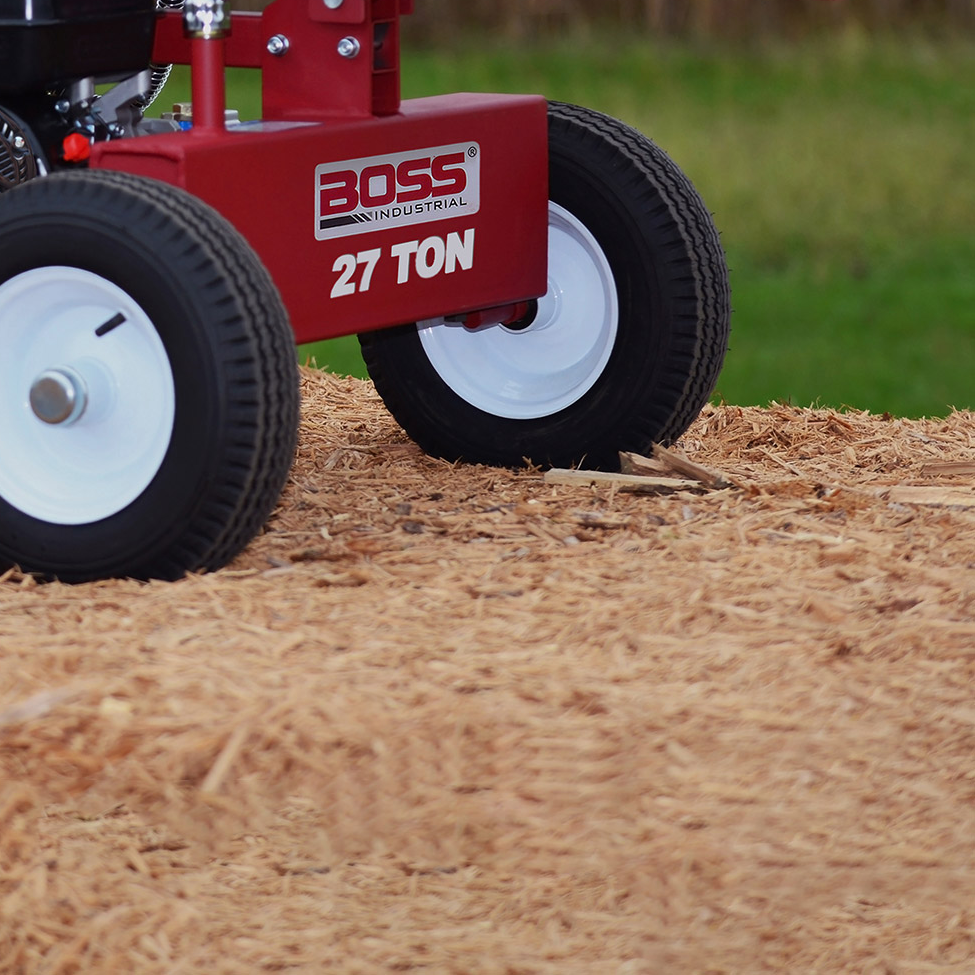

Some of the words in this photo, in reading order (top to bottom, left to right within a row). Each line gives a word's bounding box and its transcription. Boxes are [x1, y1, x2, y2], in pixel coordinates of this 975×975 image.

[320, 152, 467, 216] BOSS
[375, 197, 467, 220] INDUSTRIAL
[330, 248, 381, 298] 27
[391, 228, 475, 284] TON
